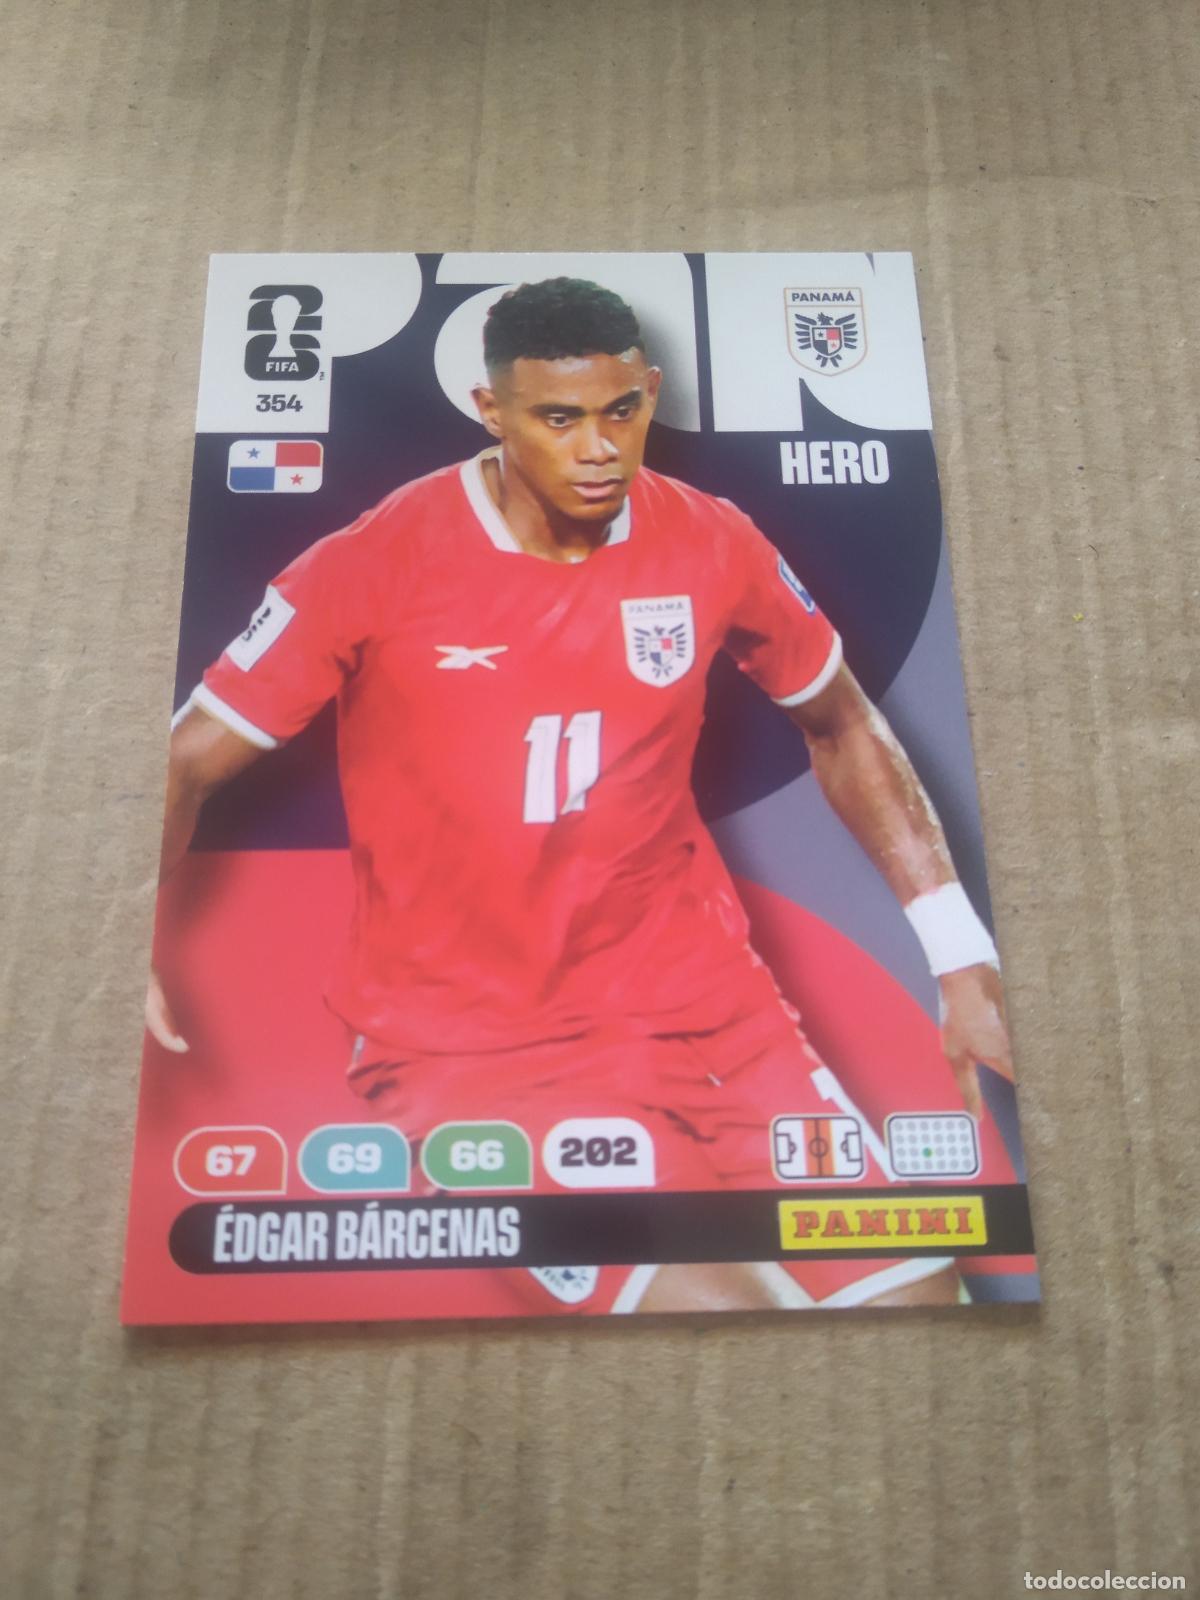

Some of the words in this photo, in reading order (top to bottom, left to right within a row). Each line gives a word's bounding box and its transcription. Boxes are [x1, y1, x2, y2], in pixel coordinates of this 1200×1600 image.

[791, 290, 855, 302] PANAMÁ
[265, 361, 300, 373] FIFA
[256, 394, 303, 412] 354
[780, 440, 890, 485] HERO
[523, 710, 602, 823] 11
[205, 1145, 257, 1176] 67
[326, 1142, 383, 1174] 69
[449, 1139, 505, 1171] 66
[559, 1136, 638, 1167] 202
[213, 1204, 329, 1263] ÉDGAR
[335, 1201, 521, 1260] BÁRCENAS
[793, 1207, 974, 1239] PANINI
